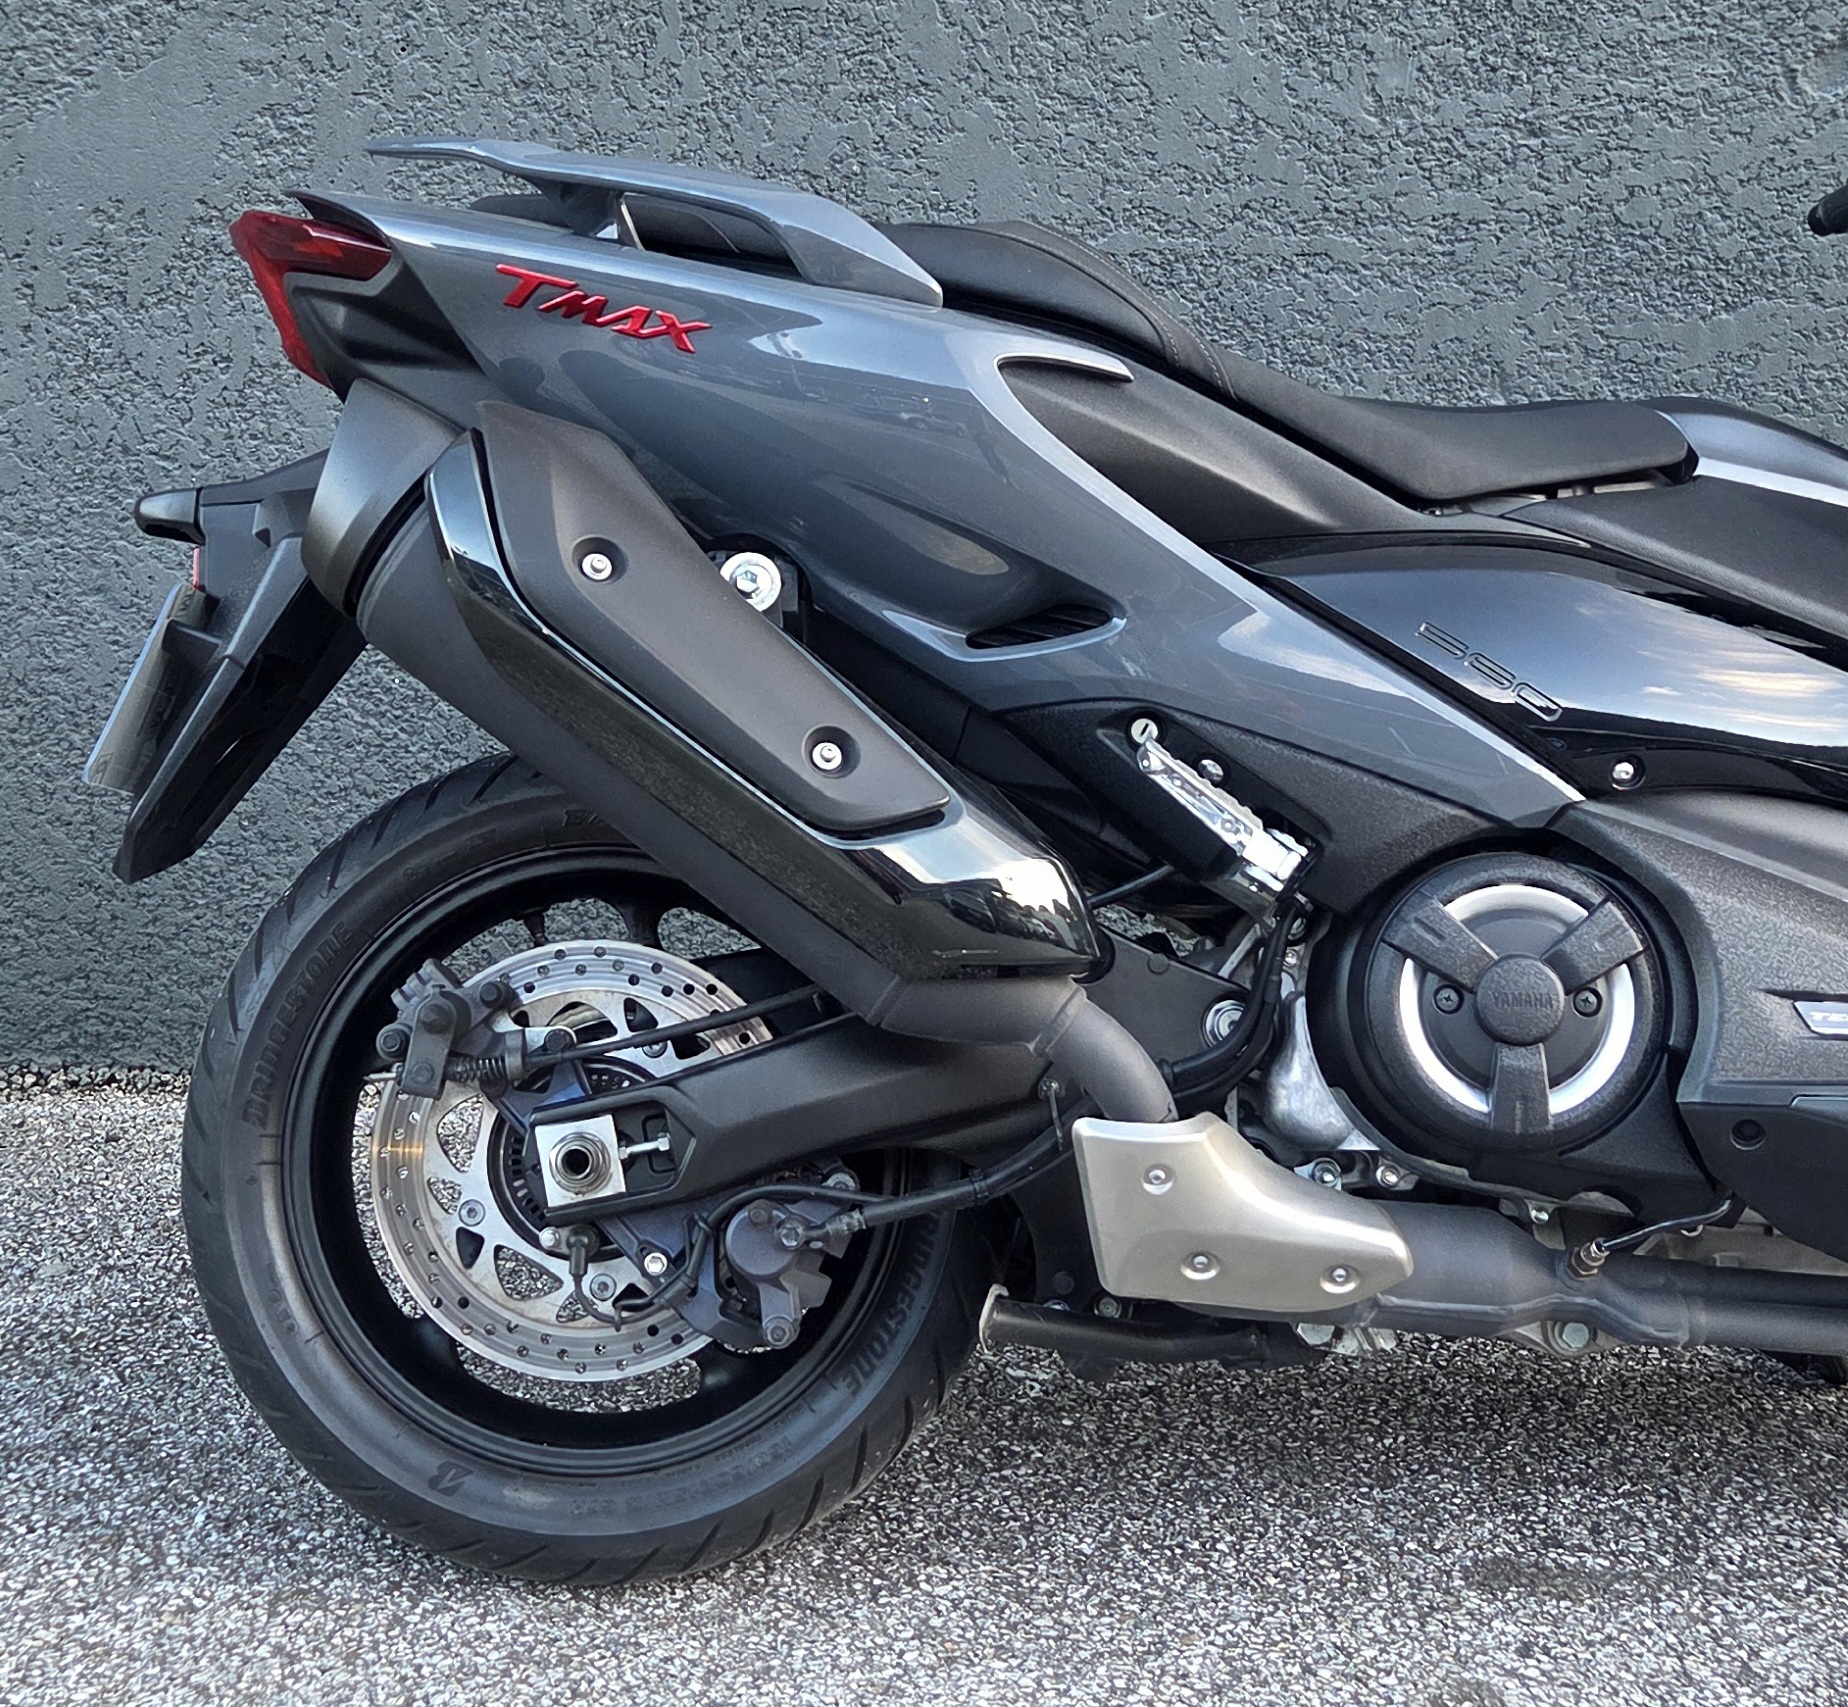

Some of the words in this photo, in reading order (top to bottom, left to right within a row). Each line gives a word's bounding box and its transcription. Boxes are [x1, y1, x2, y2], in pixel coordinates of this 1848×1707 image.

[242, 920, 352, 1130] BRIDGESTONE
[1488, 991, 1555, 1010] YAMAHA
[1810, 1011, 1848, 1022] TE
[841, 1212, 939, 1397] RIDGESTONE
